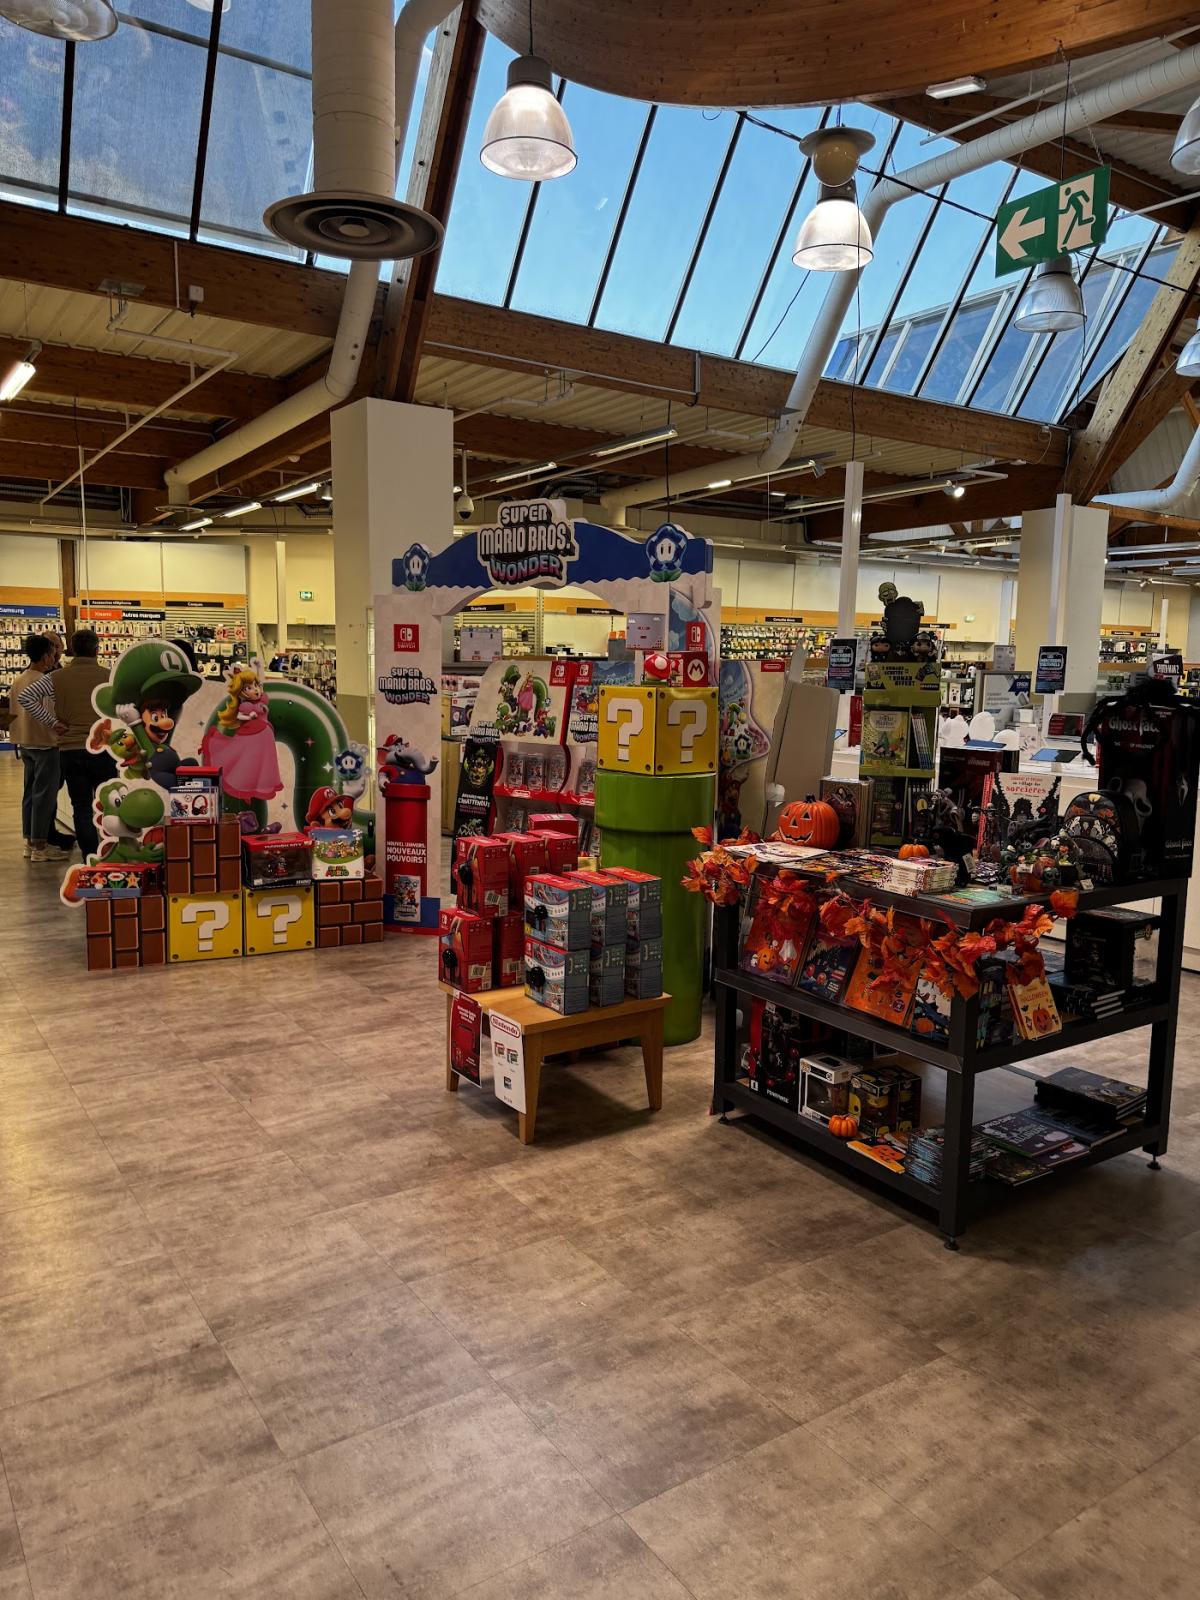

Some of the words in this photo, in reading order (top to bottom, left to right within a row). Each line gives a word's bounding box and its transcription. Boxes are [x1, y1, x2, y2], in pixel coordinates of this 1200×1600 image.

[502, 504, 548, 524] SUPER
[481, 526, 526, 555] MARIO
[528, 523, 571, 552] BROS.
[490, 554, 561, 580] WONDER
[391, 667, 420, 677] SUPER
[379, 677, 407, 690] MARIO
[408, 678, 435, 691] BROS.
[385, 691, 429, 703] WONDER
[1109, 716, 1138, 732] Ghost
[386, 847, 426, 856] NOUVEAUX
[386, 854, 423, 864] POUVOIRS
[492, 1017, 519, 1035] Nintendo
